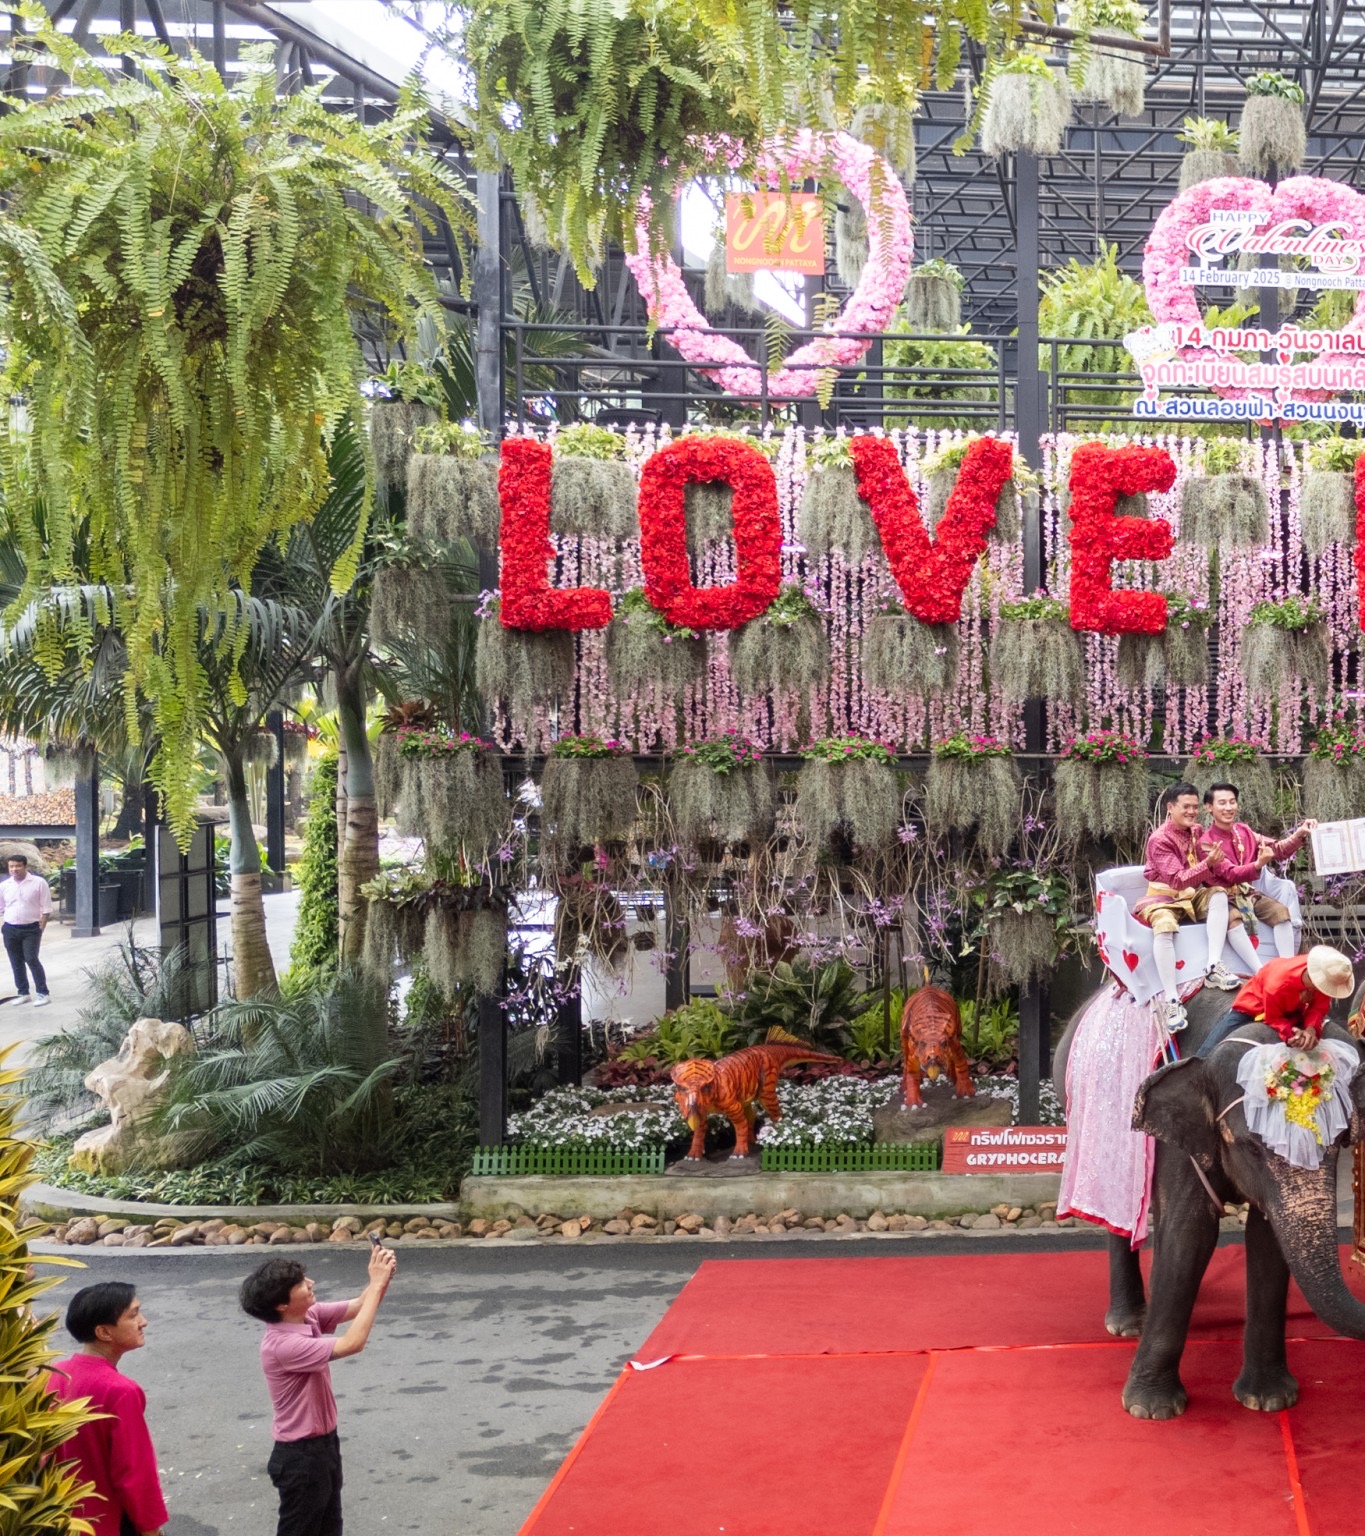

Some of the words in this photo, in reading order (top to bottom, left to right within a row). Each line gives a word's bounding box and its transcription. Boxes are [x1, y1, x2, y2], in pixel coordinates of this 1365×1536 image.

[1212, 212, 1268, 223] HAPPY
[785, 258, 817, 267] PATTAYA
[1313, 255, 1344, 265] DAY
[1182, 270, 1196, 282] 14
[1200, 270, 1249, 289] February
[1253, 271, 1280, 285] 2025
[1295, 276, 1342, 289] Nongnooch
[1176, 327, 1201, 346] 14
[1136, 400, 1157, 415] ณ
[1165, 395, 1273, 417] สวนลอยฟ้า
[498, 436, 1177, 635] LOVE
